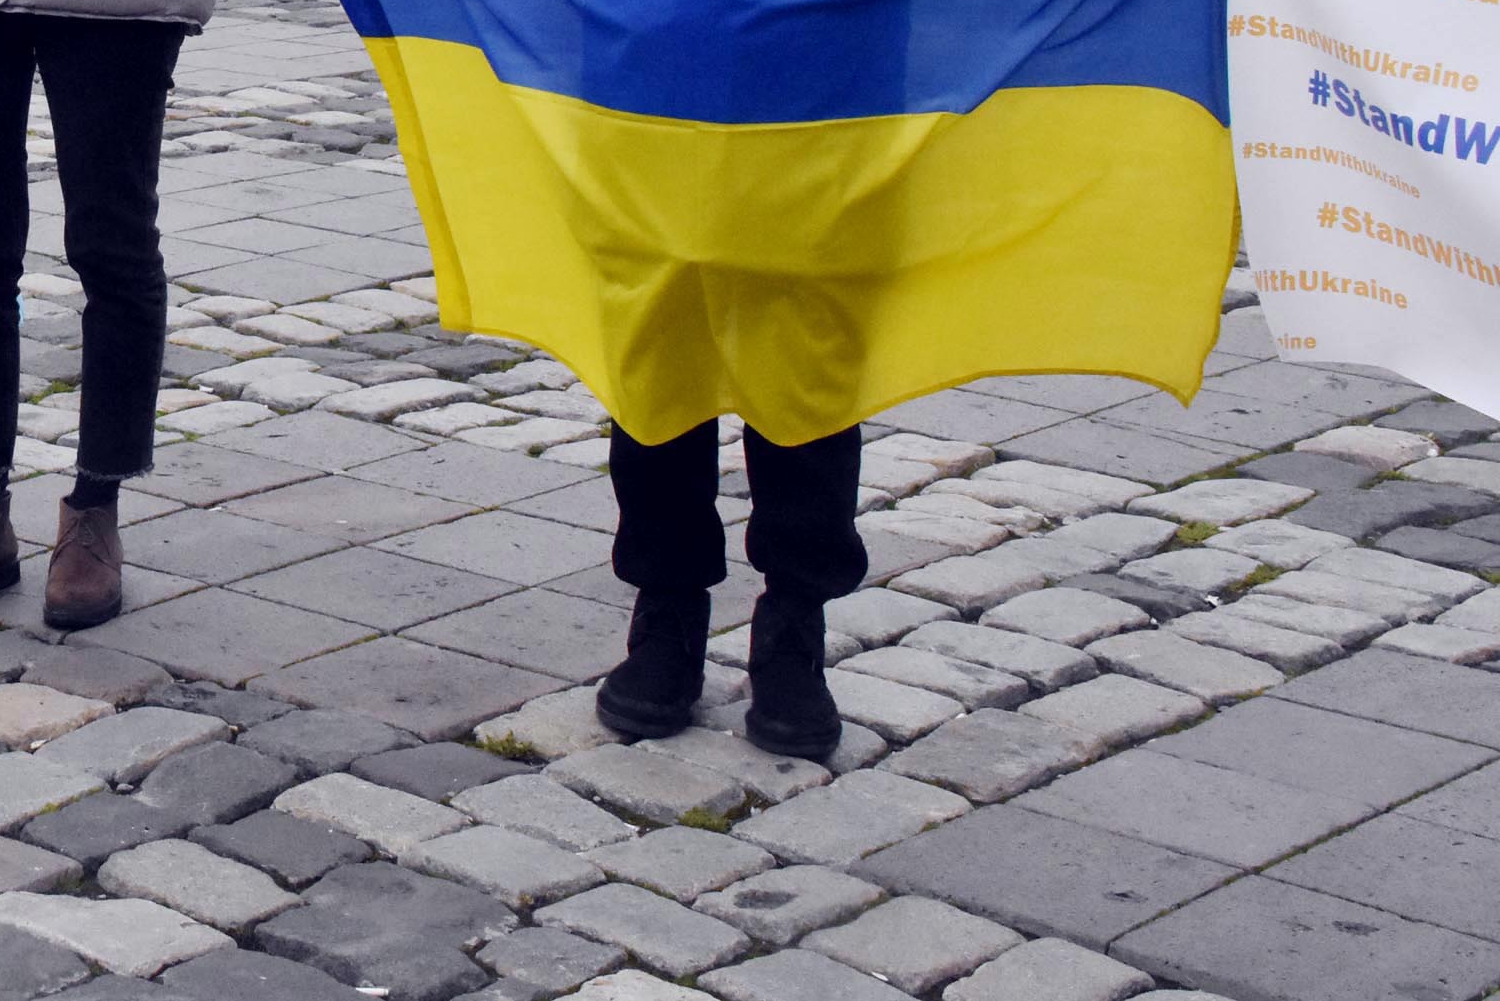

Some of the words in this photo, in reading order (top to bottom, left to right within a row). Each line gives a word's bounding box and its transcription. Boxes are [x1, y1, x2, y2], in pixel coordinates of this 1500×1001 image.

[1228, 14, 1479, 92] #StandWithUkraine
[1308, 69, 1500, 165] #StandW
[1242, 142, 1421, 199] #StandWithUkraine
[1316, 201, 1500, 288] #StandWith
